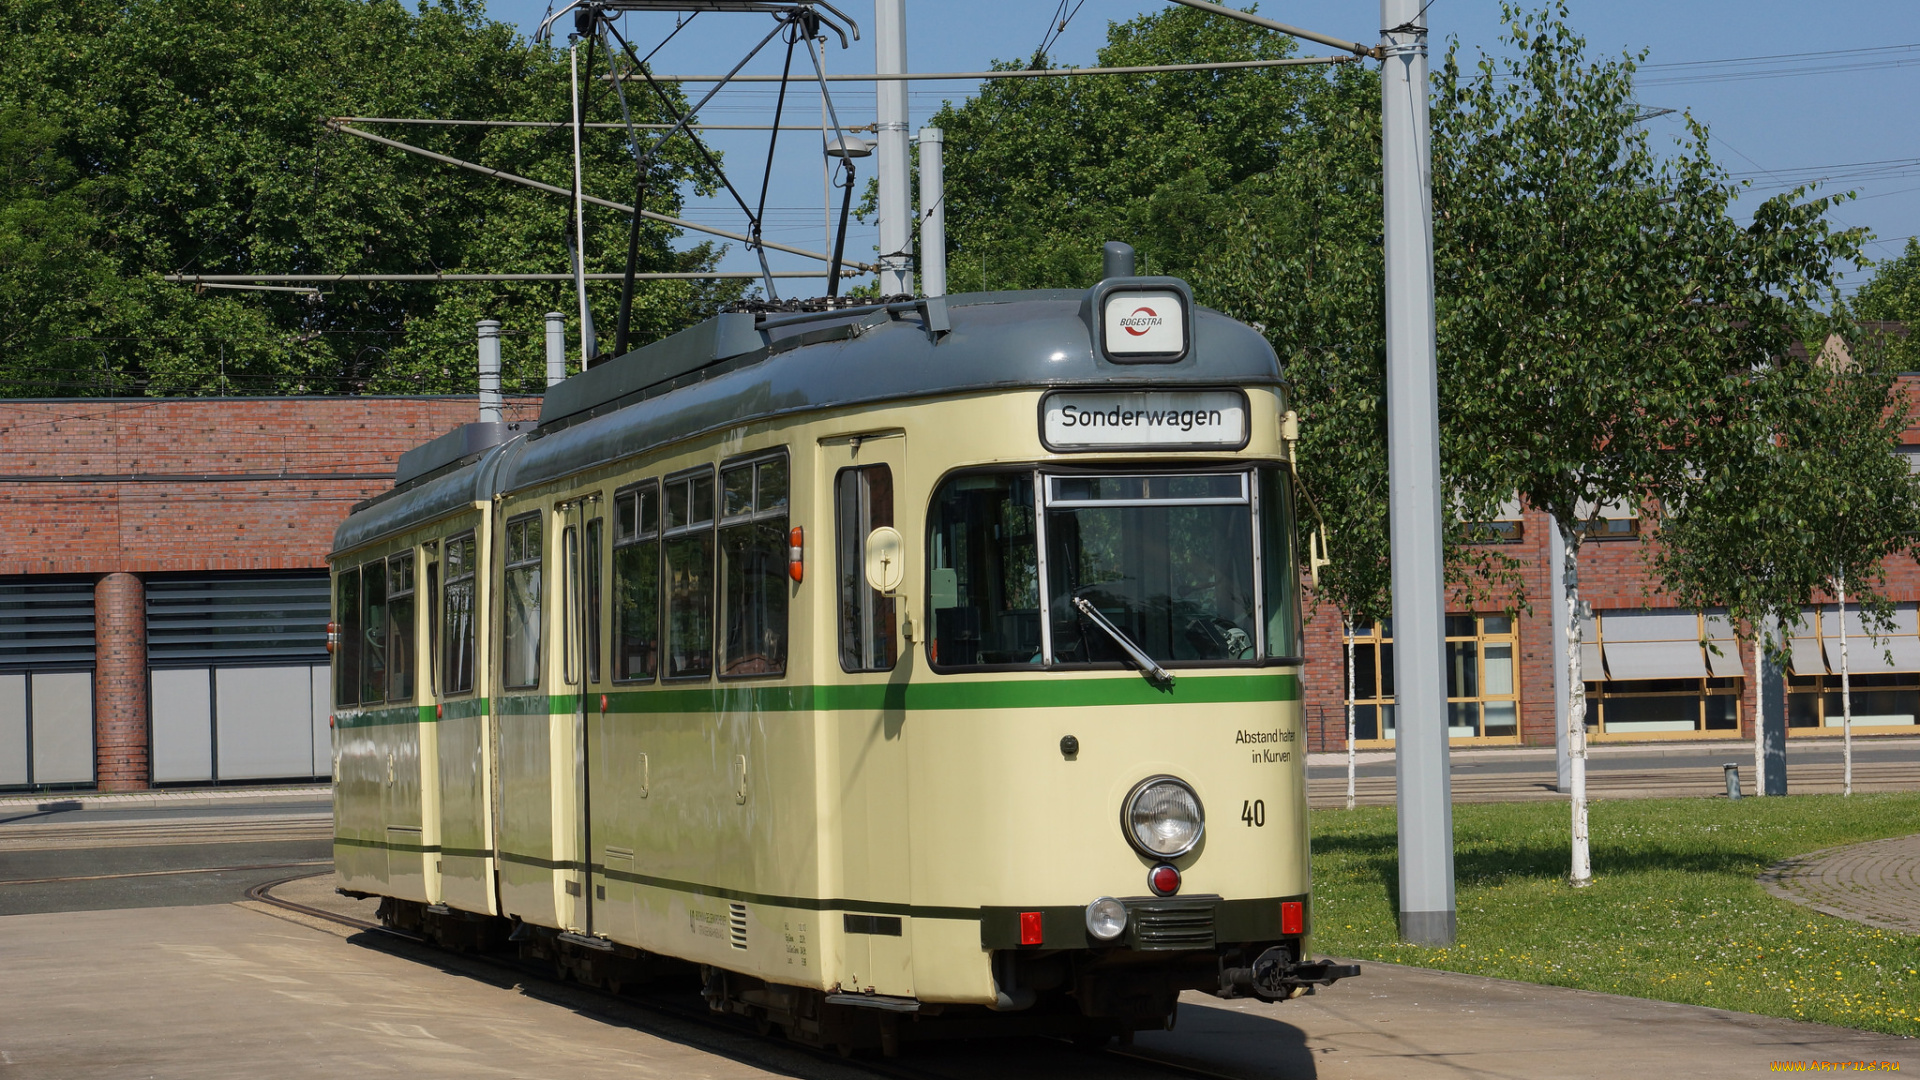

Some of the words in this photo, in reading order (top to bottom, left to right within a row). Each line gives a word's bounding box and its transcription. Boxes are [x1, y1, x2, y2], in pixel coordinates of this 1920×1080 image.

[1120, 317, 1162, 326] BOGESTRA
[1062, 405, 1221, 431] Sonderwagen
[1235, 729, 1278, 743] Abstand
[1252, 749, 1262, 763] in
[1263, 749, 1290, 762] Kurven
[1241, 799, 1265, 827] 40
